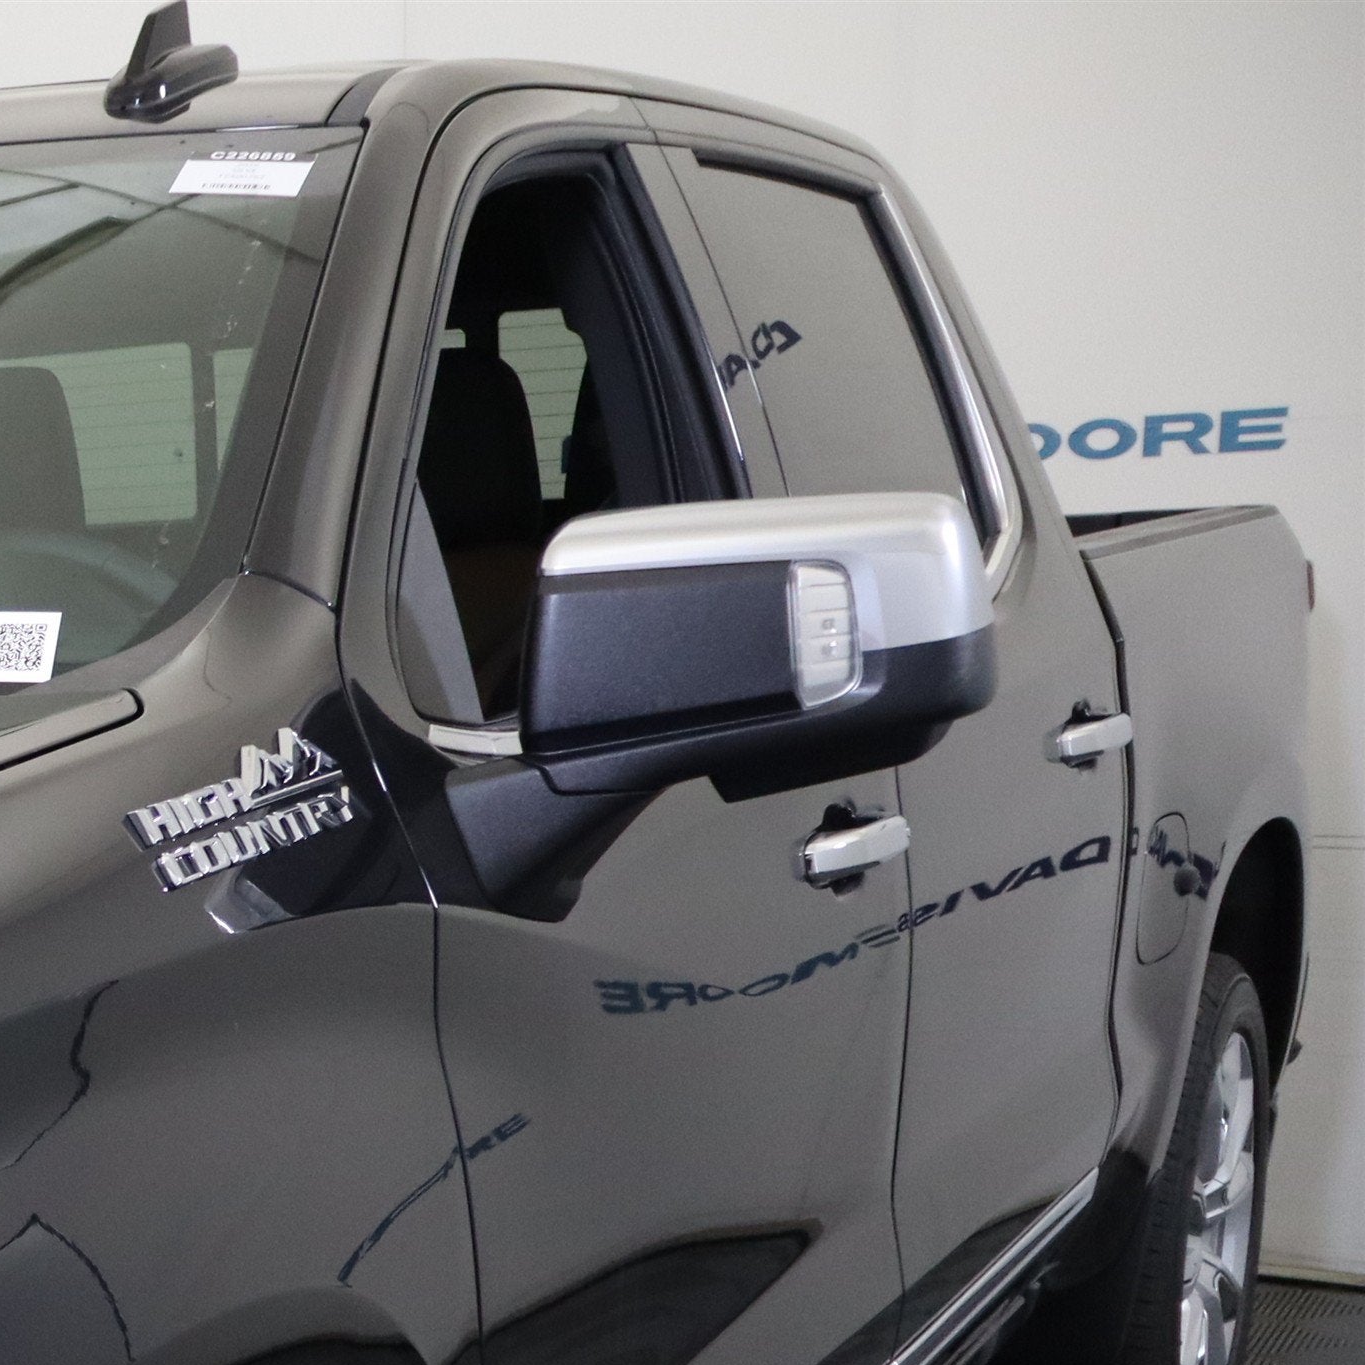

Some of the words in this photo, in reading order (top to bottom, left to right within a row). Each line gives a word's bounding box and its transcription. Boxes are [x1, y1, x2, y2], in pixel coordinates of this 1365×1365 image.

[1018, 406, 1288, 460] ORE
[123, 776, 257, 852] HIGH
[151, 785, 353, 892] COUNTRY
